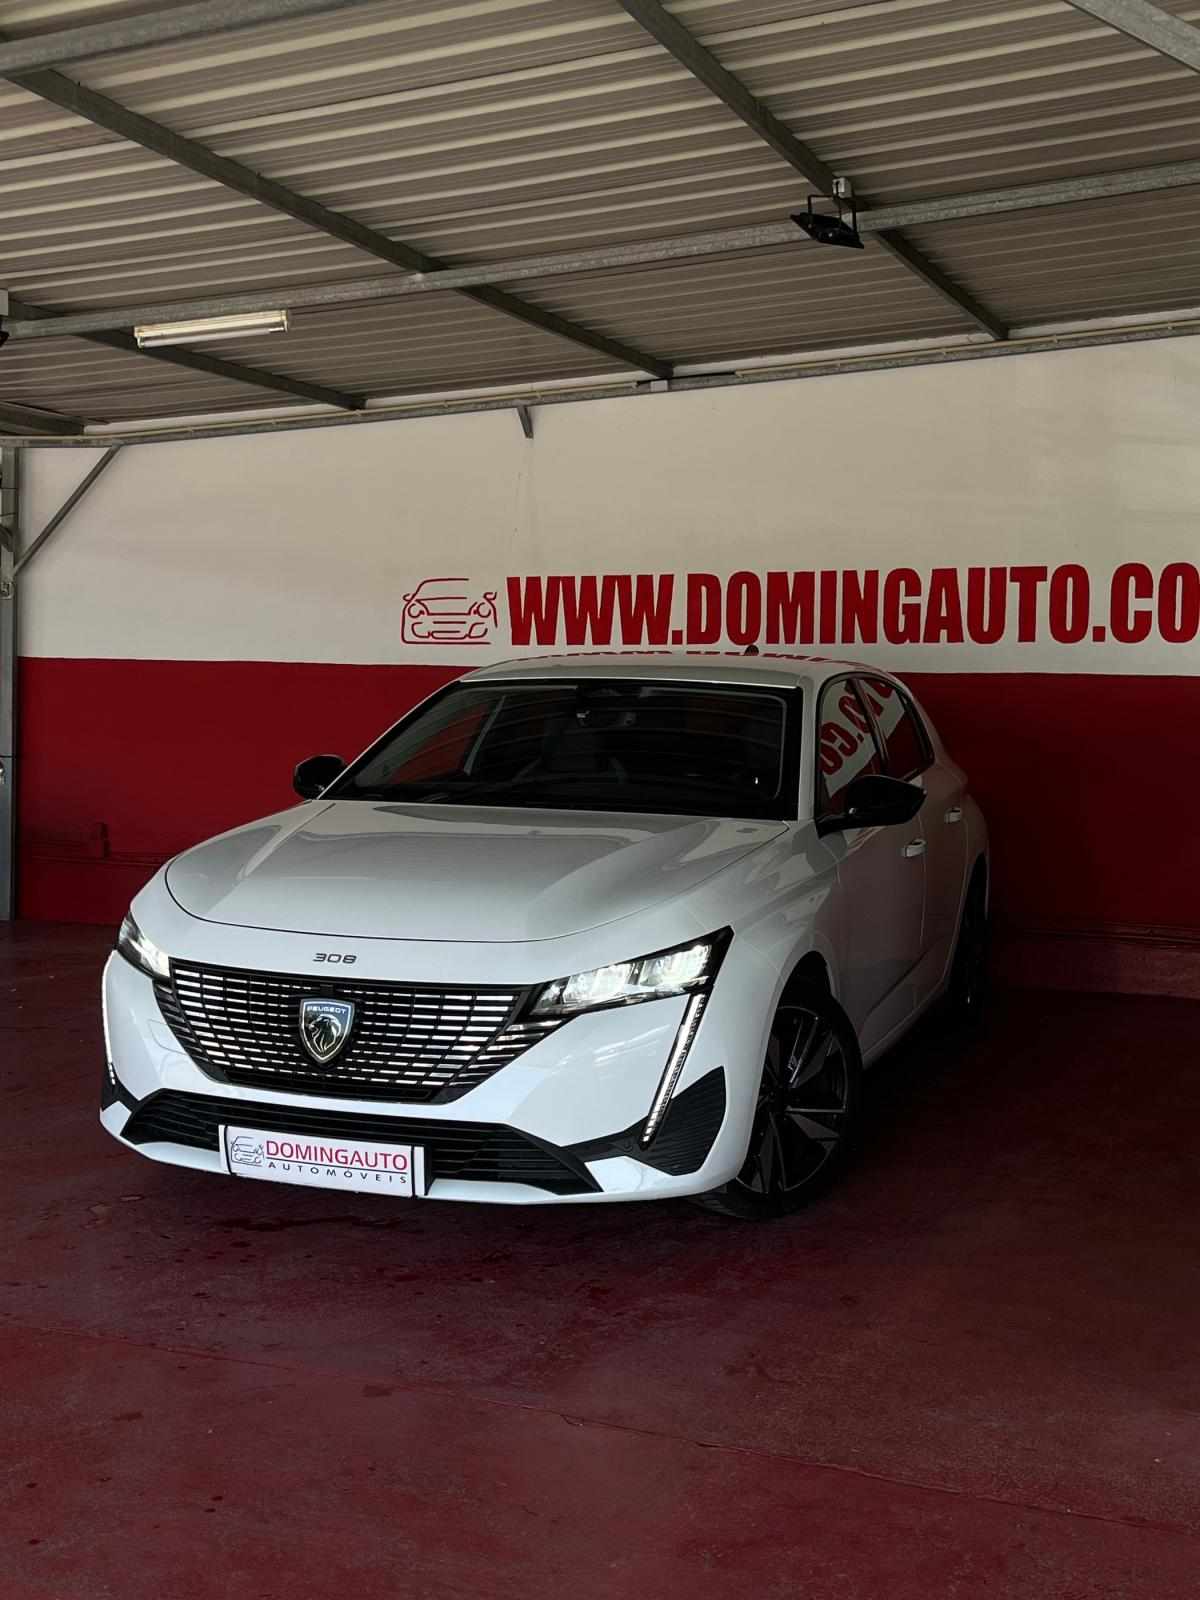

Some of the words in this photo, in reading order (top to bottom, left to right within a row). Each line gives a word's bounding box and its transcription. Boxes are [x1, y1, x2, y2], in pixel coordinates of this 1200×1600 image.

[313, 953, 357, 964] 308
[307, 1006, 345, 1014] PEUGEOT
[266, 1140, 408, 1171] DOMINGAUTO
[269, 1162, 407, 1183] AUTOMÓVEIS
